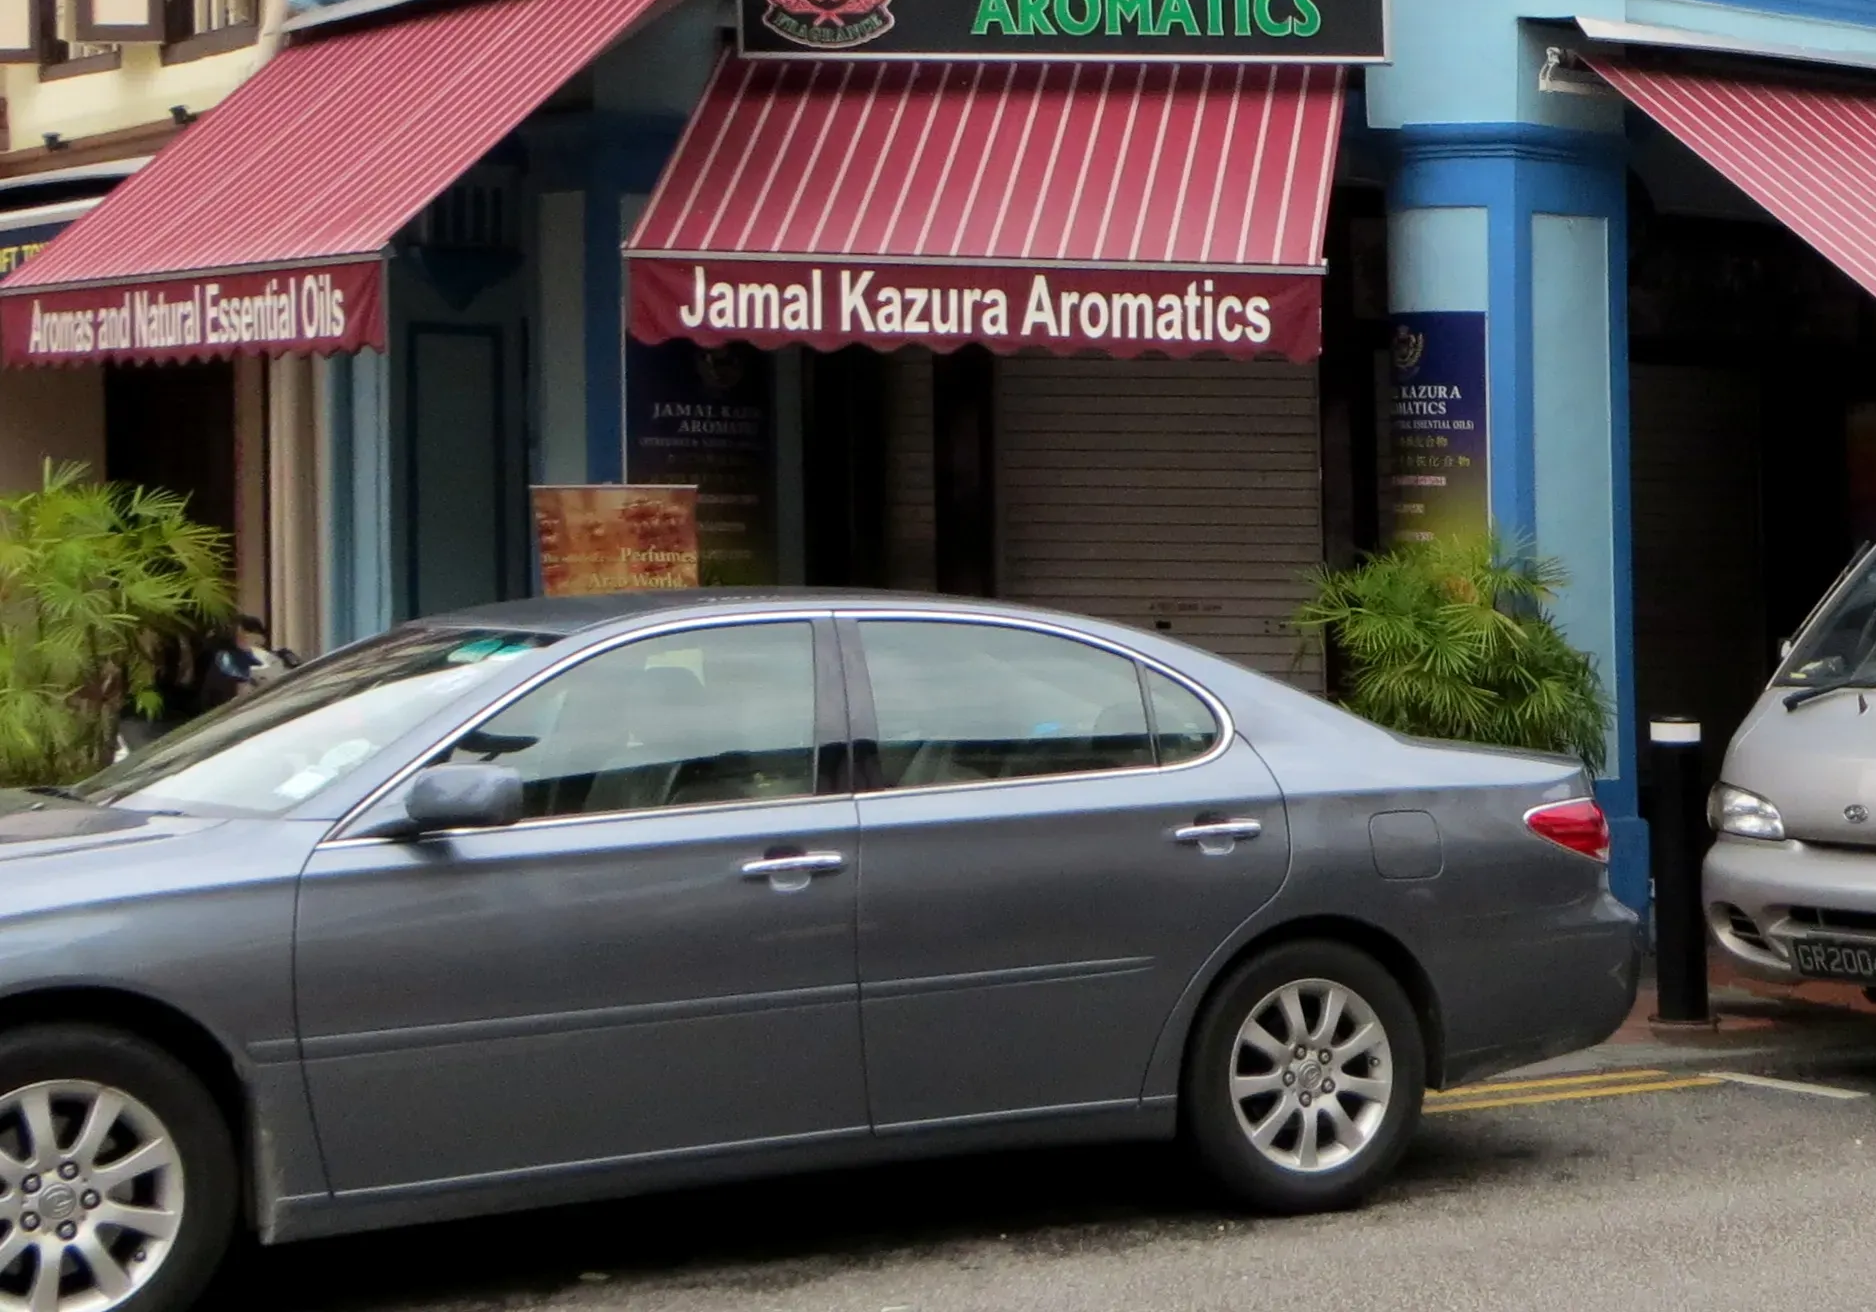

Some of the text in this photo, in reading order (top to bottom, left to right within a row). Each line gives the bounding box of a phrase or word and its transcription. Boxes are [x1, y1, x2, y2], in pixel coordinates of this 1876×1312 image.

[28, 274, 345, 354] Aromas and Natural Essential Oils
[680, 266, 1272, 343] Jamal Kazura Aromatics
[1401, 385, 1462, 400] KAZURA
[620, 544, 697, 563] Perfumes
